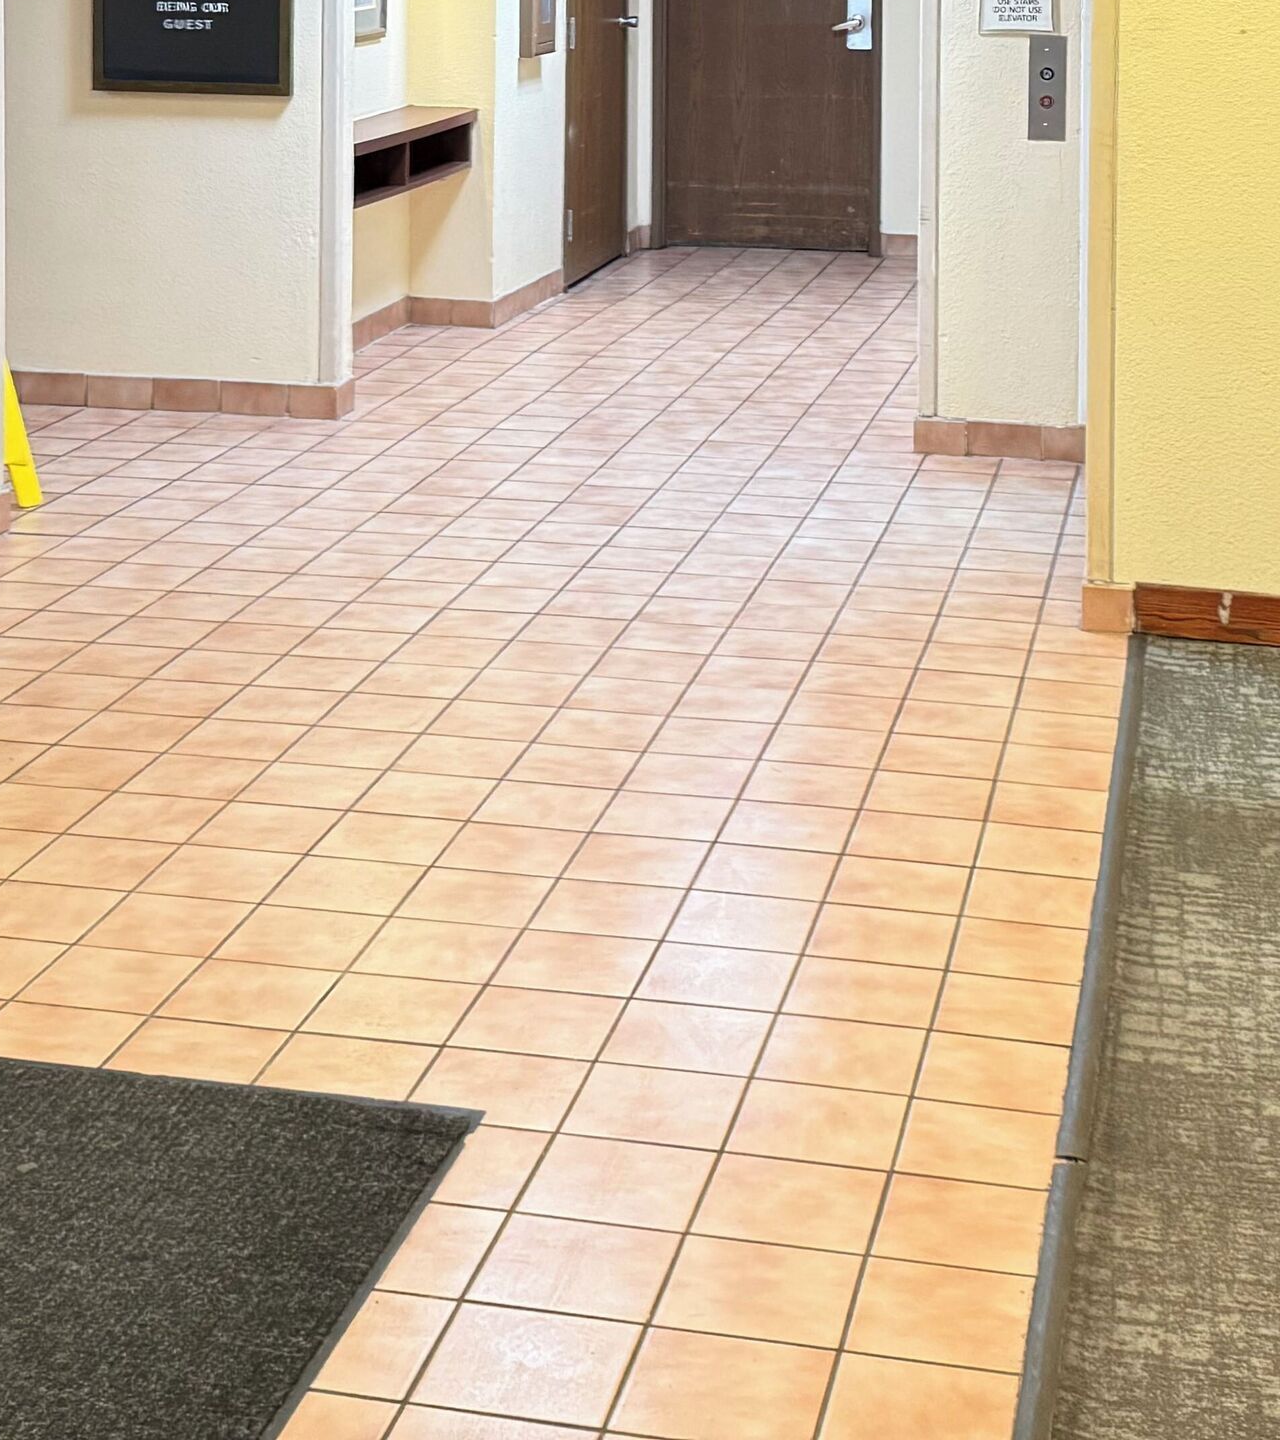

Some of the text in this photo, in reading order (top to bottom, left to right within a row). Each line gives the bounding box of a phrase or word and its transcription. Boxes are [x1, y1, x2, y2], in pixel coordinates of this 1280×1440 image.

[156, 1, 229, 13] BEING OUR
[163, 19, 213, 30] GUEST
